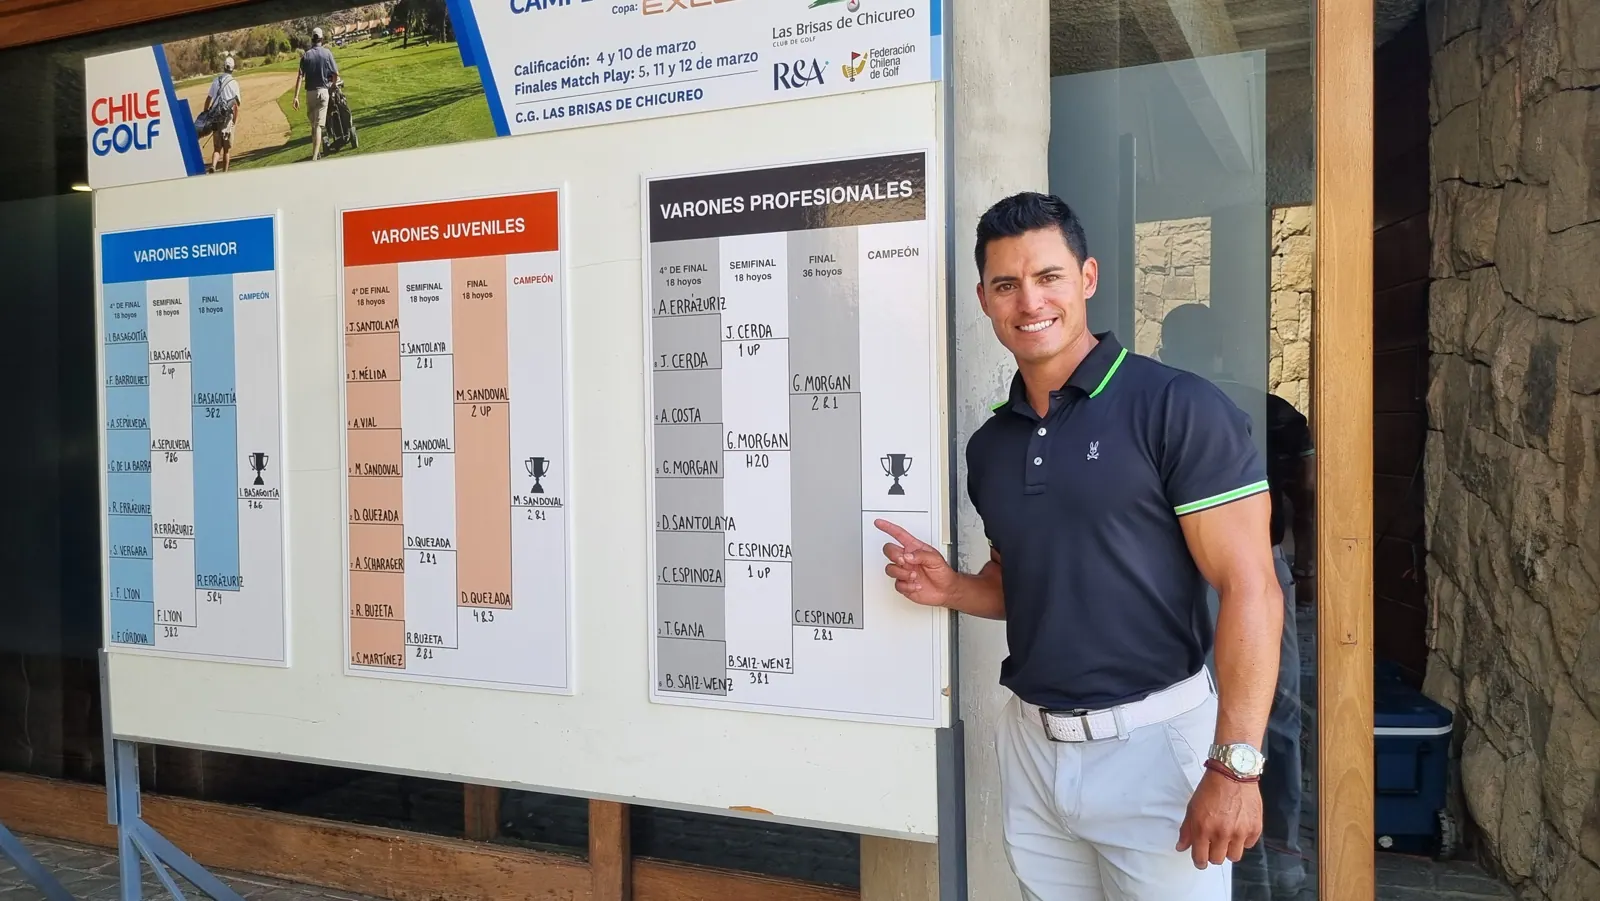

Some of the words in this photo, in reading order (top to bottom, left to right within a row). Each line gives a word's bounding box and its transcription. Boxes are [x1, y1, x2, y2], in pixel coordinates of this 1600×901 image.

[612, 4, 638, 15] Copa:
[772, 27, 792, 39] Las
[796, 20, 833, 36] Brisas
[836, 16, 853, 29] de
[856, 7, 915, 26] Chicureo
[772, 39, 789, 48] CLUB
[790, 38, 798, 46] DE
[800, 36, 816, 44] GOLF
[869, 43, 915, 58] Federación
[514, 55, 590, 76] Calificación:
[596, 52, 605, 64] 4
[608, 52, 615, 66] y
[618, 47, 633, 61] 10
[636, 44, 653, 59] de
[656, 40, 697, 56] marzo
[869, 57, 901, 69] Chilena
[514, 79, 557, 96] Finales
[561, 72, 600, 89] Match
[603, 69, 635, 84] Play:
[638, 65, 650, 78] 5,
[653, 62, 664, 76] 11
[668, 63, 676, 78] y
[679, 58, 693, 72] 12
[696, 55, 713, 70] de
[716, 51, 758, 68] marzo
[773, 58, 829, 90] R&A
[869, 70, 880, 80] de
[882, 66, 900, 78] Golf
[91, 89, 160, 126] CHILE
[515, 110, 540, 124] C.G.
[543, 107, 566, 120] LAS
[568, 100, 613, 117] BRISAS
[616, 98, 633, 111] DE
[635, 88, 704, 108] CHICUREO
[92, 119, 161, 157] GOLF
[660, 196, 745, 220] VARONES
[750, 180, 913, 212] PROFESIONALES
[371, 225, 440, 245] VARONES
[443, 217, 526, 239] JUVENILES
[133, 246, 189, 263] VARONES
[191, 241, 237, 259] SENIOR
[808, 254, 836, 264] FINAL
[867, 246, 920, 260] CAMPEÓN
[670, 265, 681, 274] DE
[684, 264, 708, 273] FINAL
[729, 258, 777, 270] SEMIFINAL
[513, 273, 554, 285] CAMPEÓN
[734, 273, 745, 282] 18
[746, 272, 772, 283] hoyos
[802, 269, 813, 278] 36
[815, 268, 843, 278] hoyos
[406, 282, 444, 292] SEMIFINAL
[466, 279, 489, 288] FINAL
[666, 278, 676, 287] 18
[677, 277, 702, 287] hoyos
[238, 290, 270, 301] CAMPEÓN
[360, 287, 370, 295] DE
[371, 285, 390, 294] FINAL
[461, 292, 471, 300] 18
[471, 291, 494, 301] hoyos
[124, 301, 141, 309] FINAL
[152, 299, 183, 307] SEMIFINAL
[201, 295, 220, 303] FINAL
[357, 298, 364, 306] 18
[365, 298, 386, 307] hoyos
[409, 295, 418, 303] 18
[419, 294, 440, 304] hoyos
[120, 312, 138, 320] hoyos
[156, 309, 163, 317] 18
[163, 309, 180, 318] hoyos
[198, 306, 206, 314] 18
[205, 306, 224, 315] hoyos
[737, 323, 773, 339] CERDA
[738, 343, 743, 357] 1
[671, 351, 709, 369] CERDA
[804, 373, 852, 392] MORGAN
[467, 387, 511, 401] SANDOVAL
[471, 404, 478, 418] 2
[480, 405, 493, 417] UP
[671, 407, 702, 423] COSTA
[738, 432, 788, 449] MORGAN
[417, 454, 422, 468] 1
[673, 459, 718, 476] MORGAN
[362, 508, 400, 522] QUEZADA
[120, 545, 148, 557] VERGARA
[672, 566, 722, 584] ESPINOZA
[747, 564, 753, 578] 1
[123, 587, 141, 600] LYON
[364, 603, 394, 617] BUZETA
